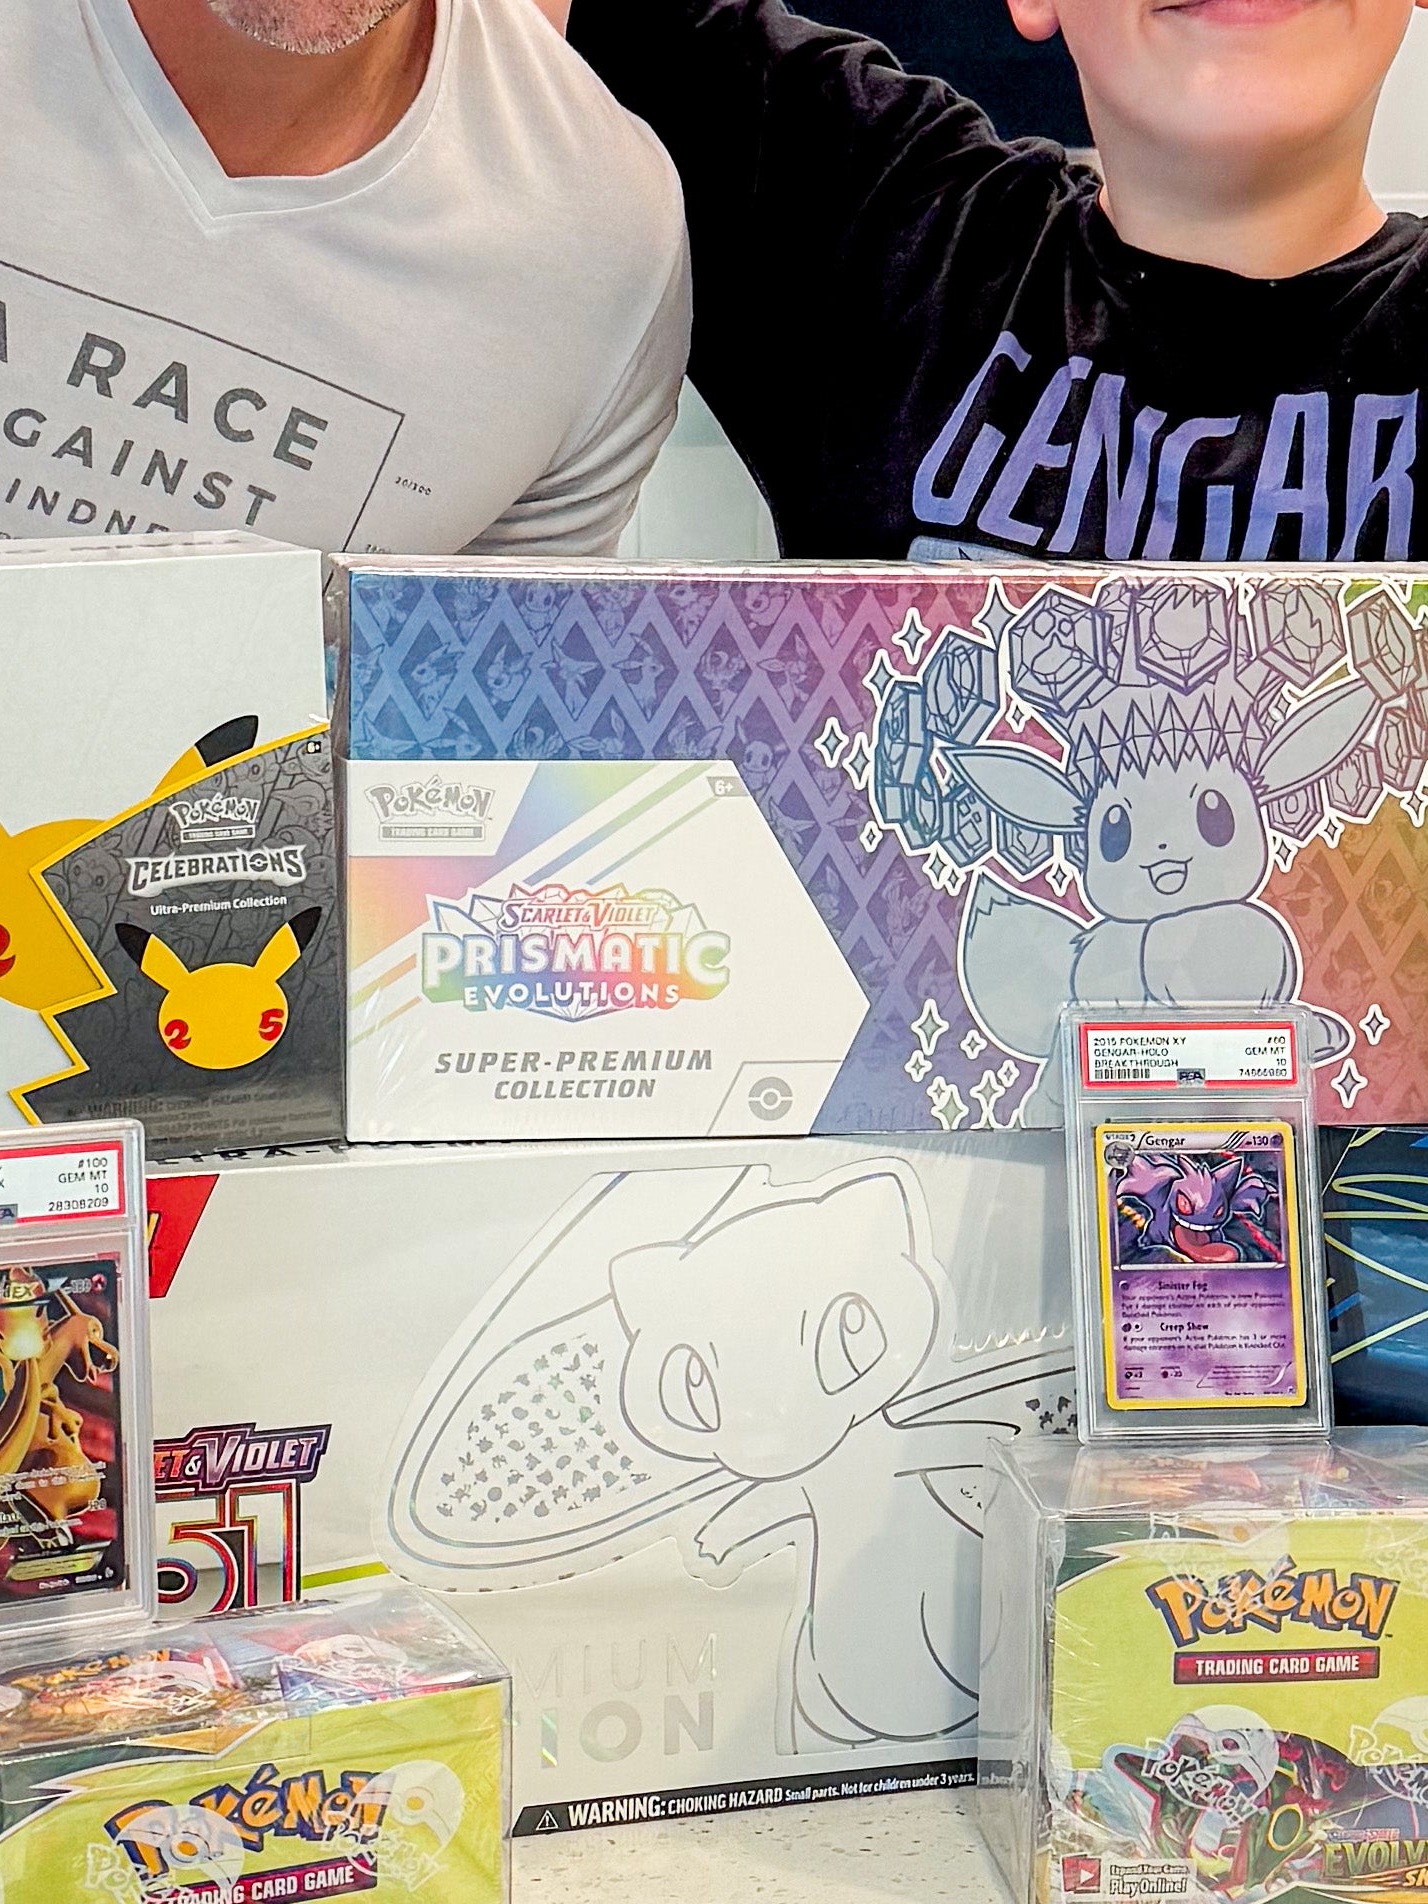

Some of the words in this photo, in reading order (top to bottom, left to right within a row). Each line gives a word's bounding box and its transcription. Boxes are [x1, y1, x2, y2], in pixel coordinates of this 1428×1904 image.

[66, 331, 329, 472] RACE
[911, 329, 1420, 562] GENGAR
[714, 780, 734, 796] 6+
[130, 846, 305, 893] CELEBRATIONS
[150, 899, 232, 917] Ultra-Premium
[232, 895, 288, 910] Collection
[423, 931, 732, 987] PRISMATIC
[464, 982, 681, 1008] EVOLUTIONS
[1120, 1037, 1169, 1046] POKEMON
[1245, 1047, 1268, 1056] GEM
[1270, 1047, 1286, 1055] MT
[434, 1049, 713, 1075] SUPER-PREMIUM
[493, 1078, 656, 1101] COLLECTION
[1145, 1136, 1185, 1147] Gengar
[58, 1172, 85, 1184] GEM
[90, 1170, 107, 1182] MT
[95, 1182, 109, 1194] 10
[194, 1435, 319, 1485] VIOLET
[1196, 1658, 1263, 1676] TRADING
[1269, 1656, 1310, 1675] CARD
[1314, 1654, 1360, 1673] GAME
[567, 1794, 667, 1828] WARNING:
[668, 1791, 728, 1815] CHOKING
[729, 1786, 783, 1810] HAZARD
[840, 1781, 858, 1797] Not
[873, 1776, 911, 1793] children
[912, 1773, 939, 1791] under
[251, 1875, 299, 1901] CARD
[303, 1865, 355, 1891] GAME
[1110, 1878, 1138, 1896] Play
[1139, 1876, 1187, 1894] Online!
